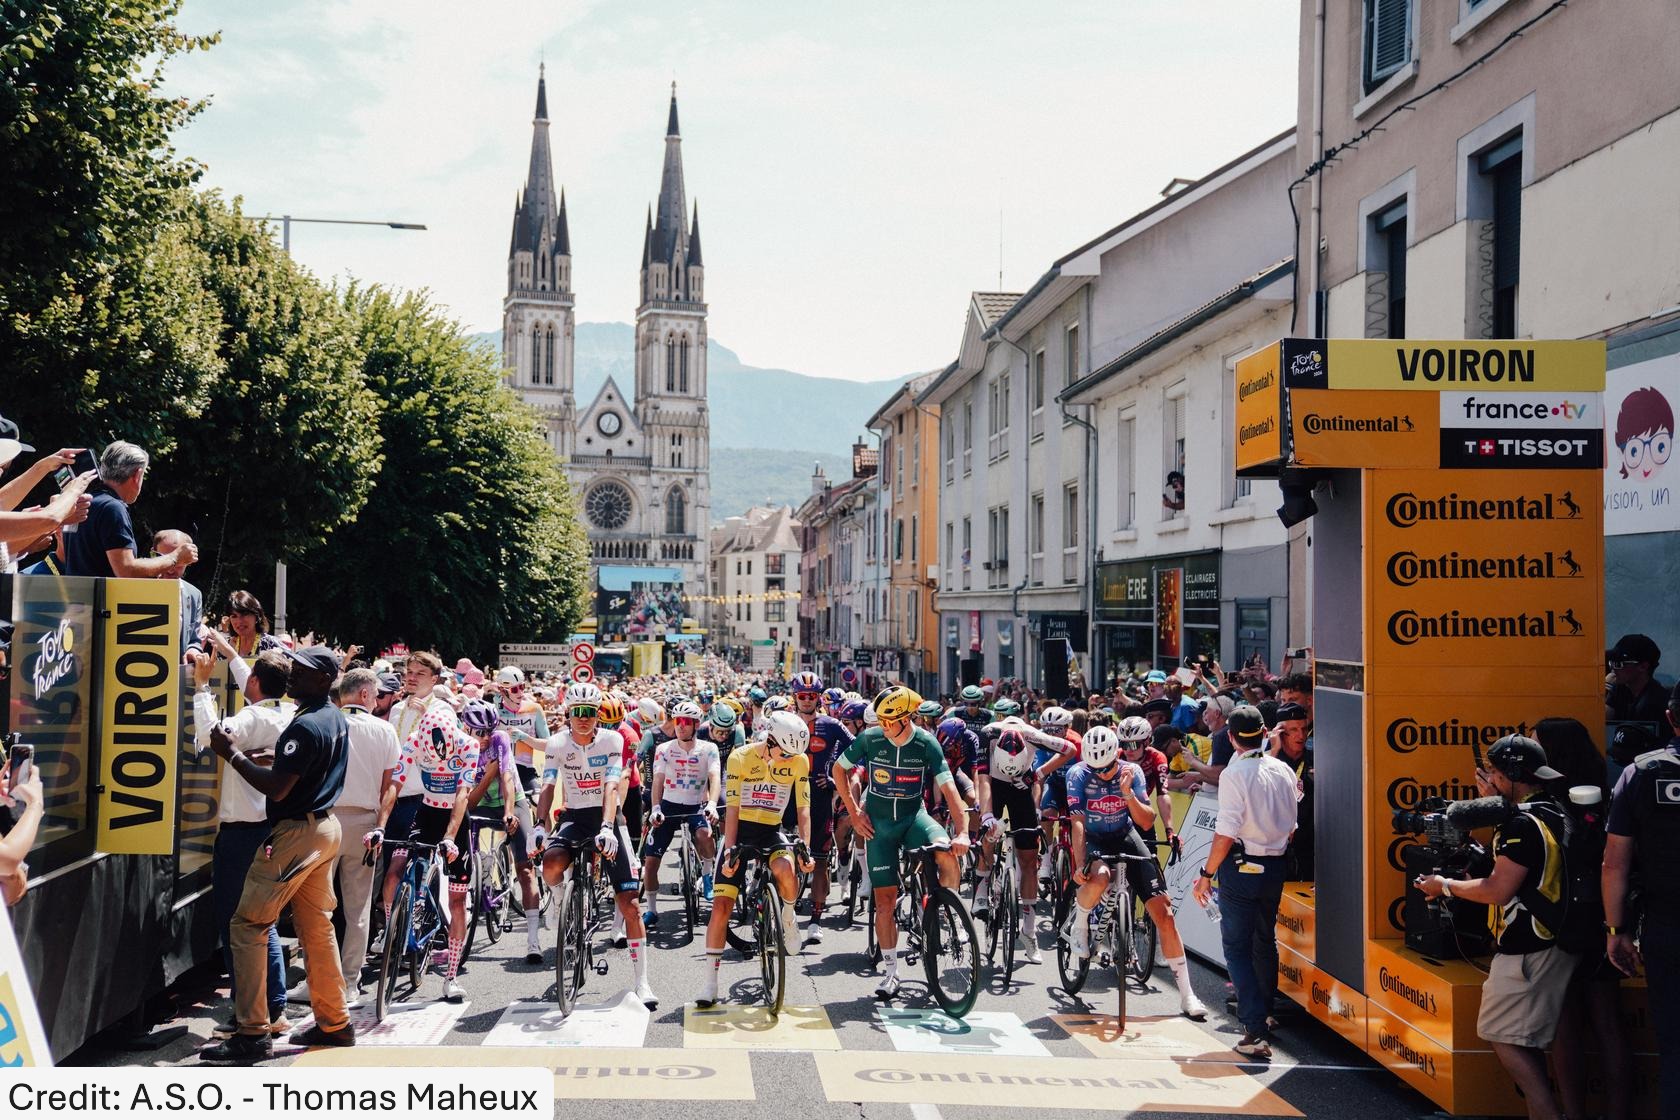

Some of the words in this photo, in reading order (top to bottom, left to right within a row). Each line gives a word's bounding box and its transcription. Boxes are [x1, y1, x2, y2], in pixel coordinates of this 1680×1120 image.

[1397, 348, 1534, 382] VOIRON
[1239, 371, 1270, 402] Continental
[1239, 421, 1270, 446] Continental
[1302, 413, 1399, 434] Continental
[1386, 492, 1554, 528] Continental
[1651, 487, 1670, 506] un
[1386, 550, 1555, 587] Continental
[1387, 609, 1556, 645] Continental
[37, 618, 71, 669] Tour
[33, 653, 74, 700] france
[109, 603, 169, 830] VOIRON
[573, 772, 601, 780] UAE
[773, 767, 793, 777] LCL
[751, 799, 774, 807] XRG
[753, 784, 777, 793] UAE
[1379, 966, 1428, 1012] Continental
[1379, 1026, 1428, 1075] Continental
[853, 1067, 1181, 1090] Continental
